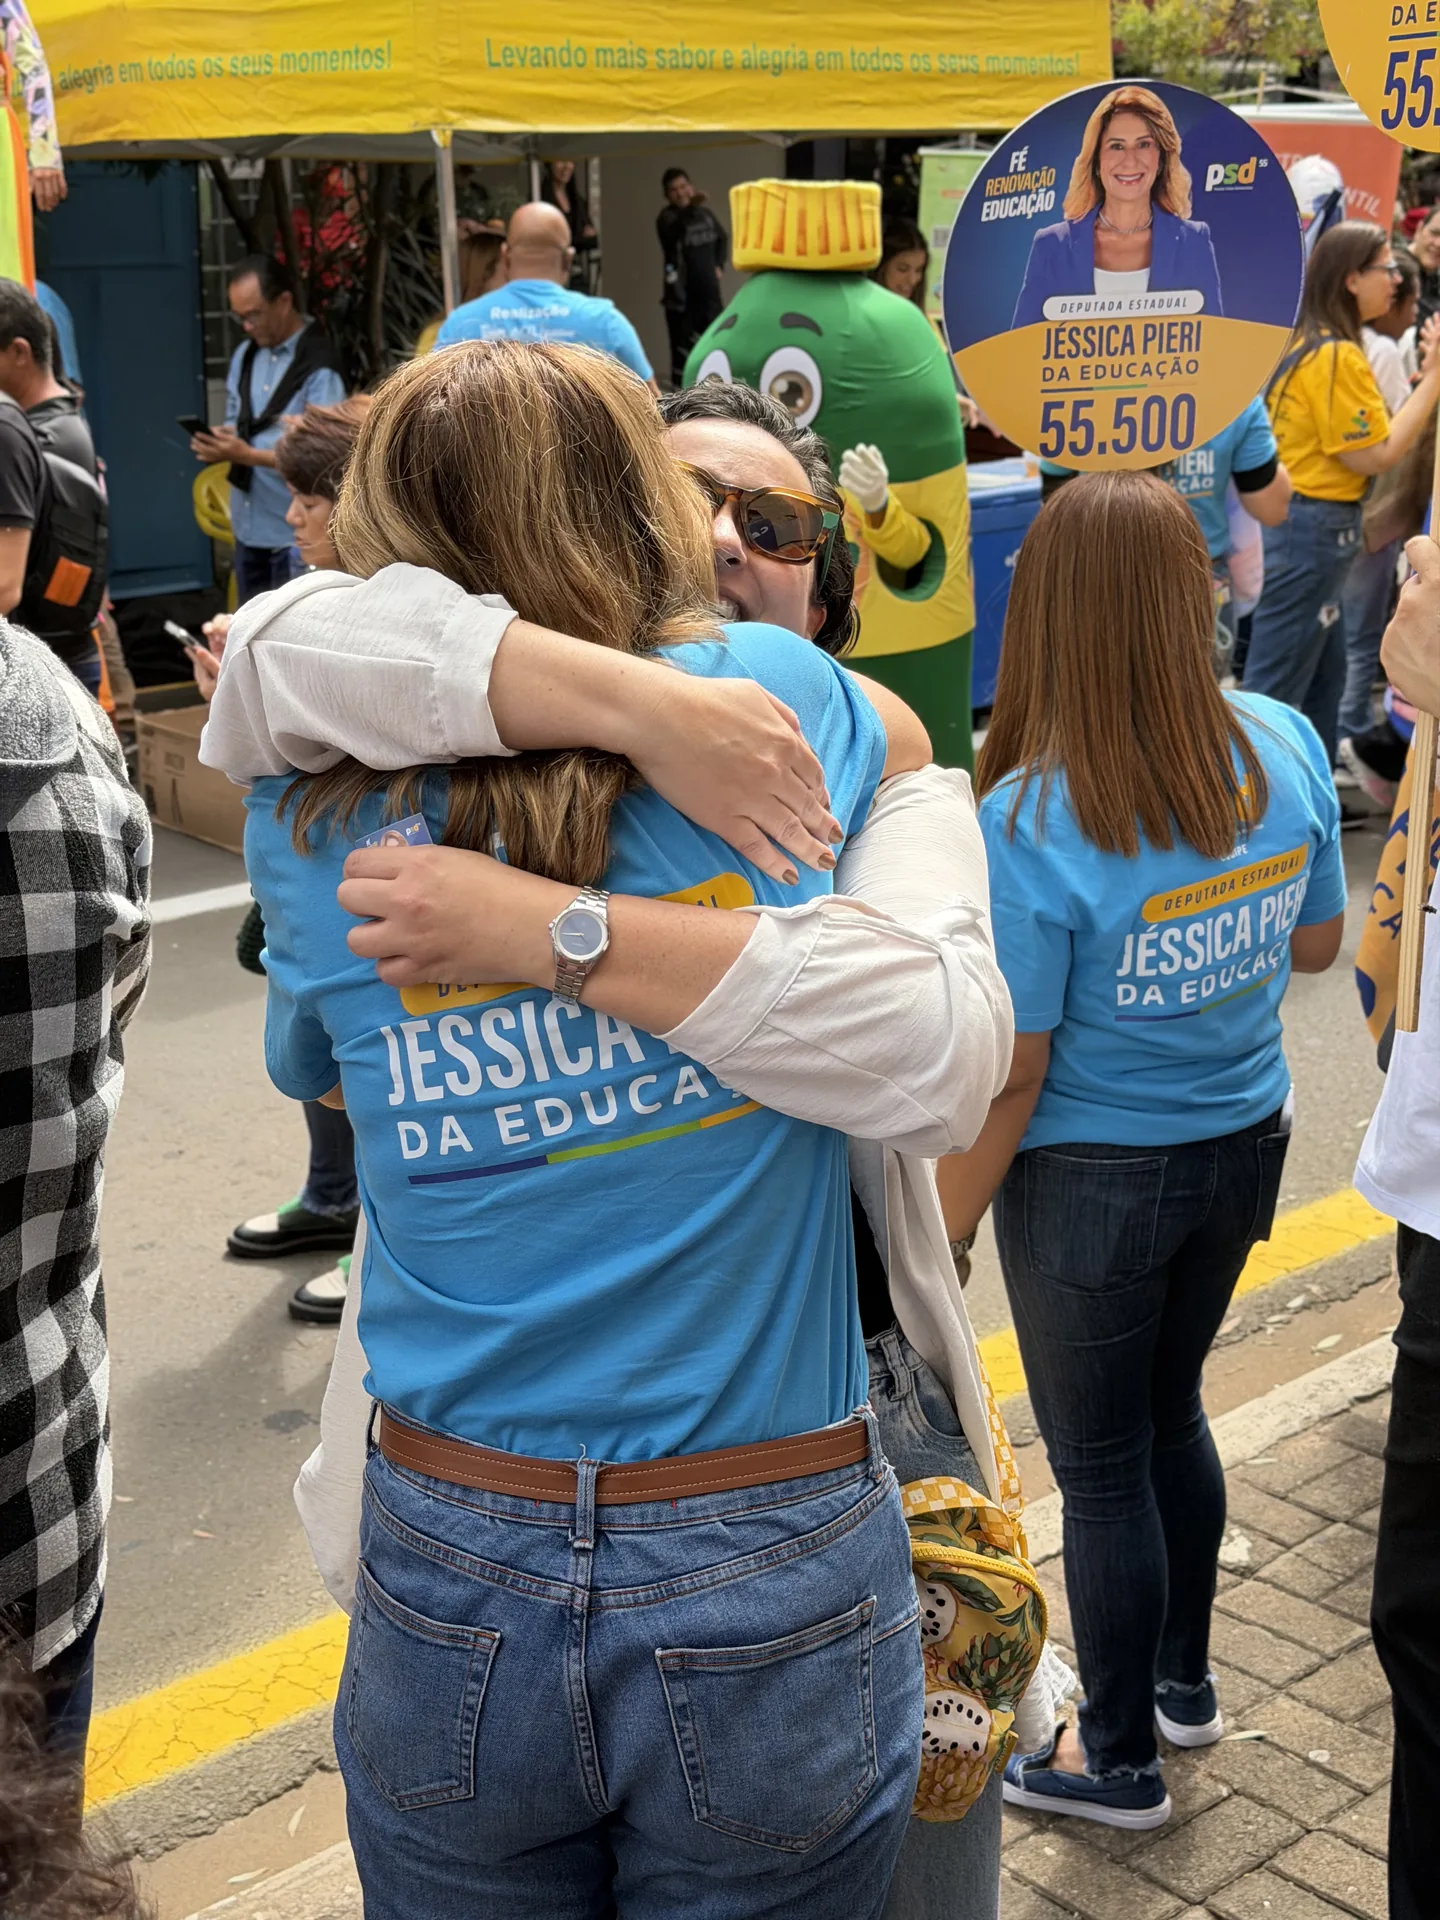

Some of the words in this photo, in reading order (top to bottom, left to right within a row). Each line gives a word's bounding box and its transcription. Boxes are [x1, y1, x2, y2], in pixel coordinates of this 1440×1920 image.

[1391, 5, 1417, 26] DA
[1425, 0, 1440, 23] E
[58, 60, 115, 95] alegria
[119, 60, 144, 83] em
[148, 53, 196, 81] todos
[202, 55, 224, 79] os
[229, 53, 273, 77] seus
[279, 40, 392, 73] momentos!
[485, 38, 588, 69] Levando
[594, 40, 648, 69] mais
[655, 41, 716, 70] sabor
[722, 48, 734, 70] e
[740, 42, 808, 77] alegria
[814, 49, 844, 71] em
[850, 46, 904, 73] todos
[909, 51, 932, 74] os
[938, 52, 980, 74] seus
[985, 51, 1081, 77] momentos!
[1009, 145, 1030, 173] FÉ
[1205, 156, 1257, 192] psd
[985, 166, 1056, 197] RENOVAÇÃO
[981, 188, 1056, 222] EDUCAÇÃO
[1060, 300, 1123, 314] DEPUTADA
[1128, 297, 1188, 311] ESTADUAL
[1042, 320, 1135, 361] JÉSSICA
[1142, 320, 1202, 356] PIERI
[1042, 366, 1071, 382] DA
[1080, 356, 1200, 380] EDUCAÇÃO
[1039, 393, 1197, 459] 55.500
[1173, 449, 1215, 476] IERI
[1164, 878, 1236, 912] DEPUTADA
[1116, 904, 1251, 978] JÉSSICA
[1259, 875, 1308, 945] PIER
[1116, 983, 1165, 1007] DA
[1180, 941, 1286, 1005] EDUCAÇ
[397, 1115, 474, 1160] DA
